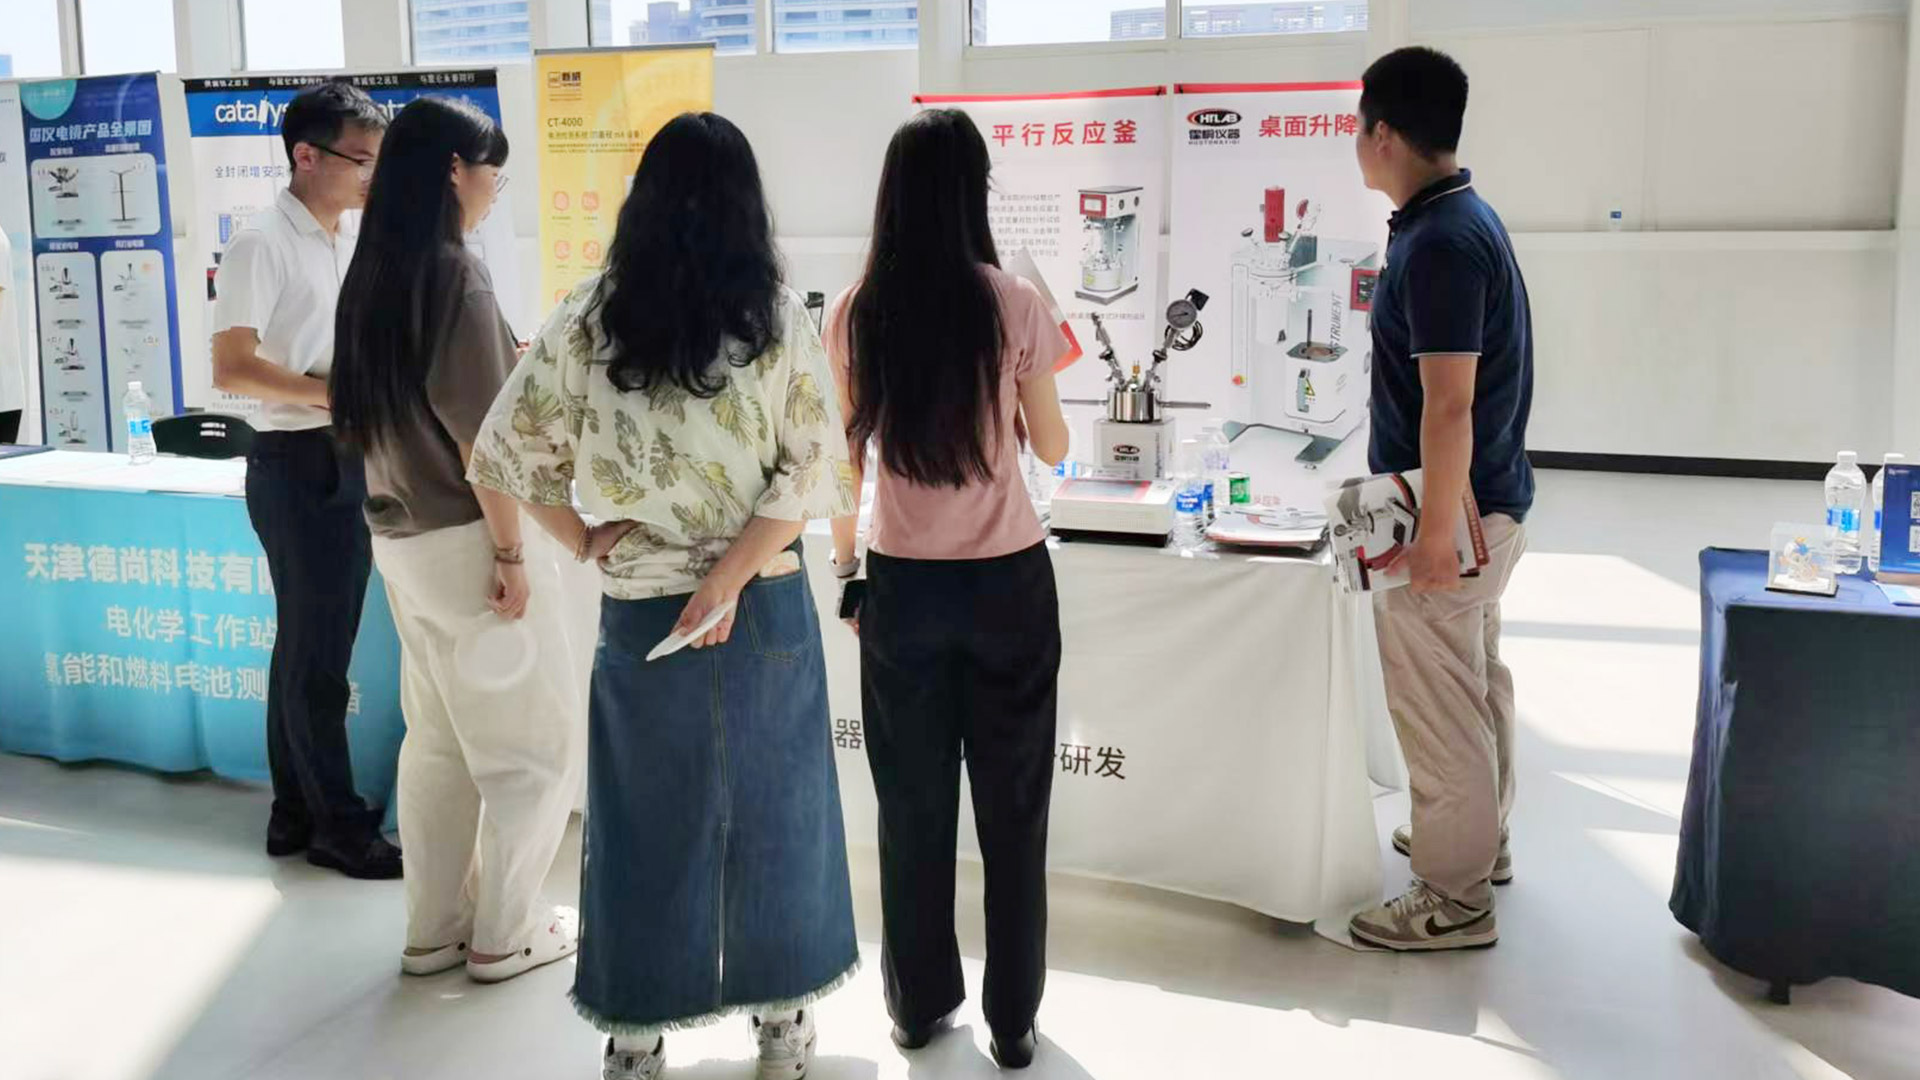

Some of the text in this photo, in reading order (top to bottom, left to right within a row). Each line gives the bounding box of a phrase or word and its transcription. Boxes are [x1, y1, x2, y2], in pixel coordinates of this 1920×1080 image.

[29, 119, 152, 143] 国仪电镜产品全景图
[547, 117, 583, 127] CT-4000
[992, 119, 1138, 147] 平行反应釜
[1258, 113, 1358, 138] 桌面升降
[106, 604, 277, 649] 电化学工作站
[834, 718, 862, 750] 器
[1059, 742, 1126, 780] 研发
